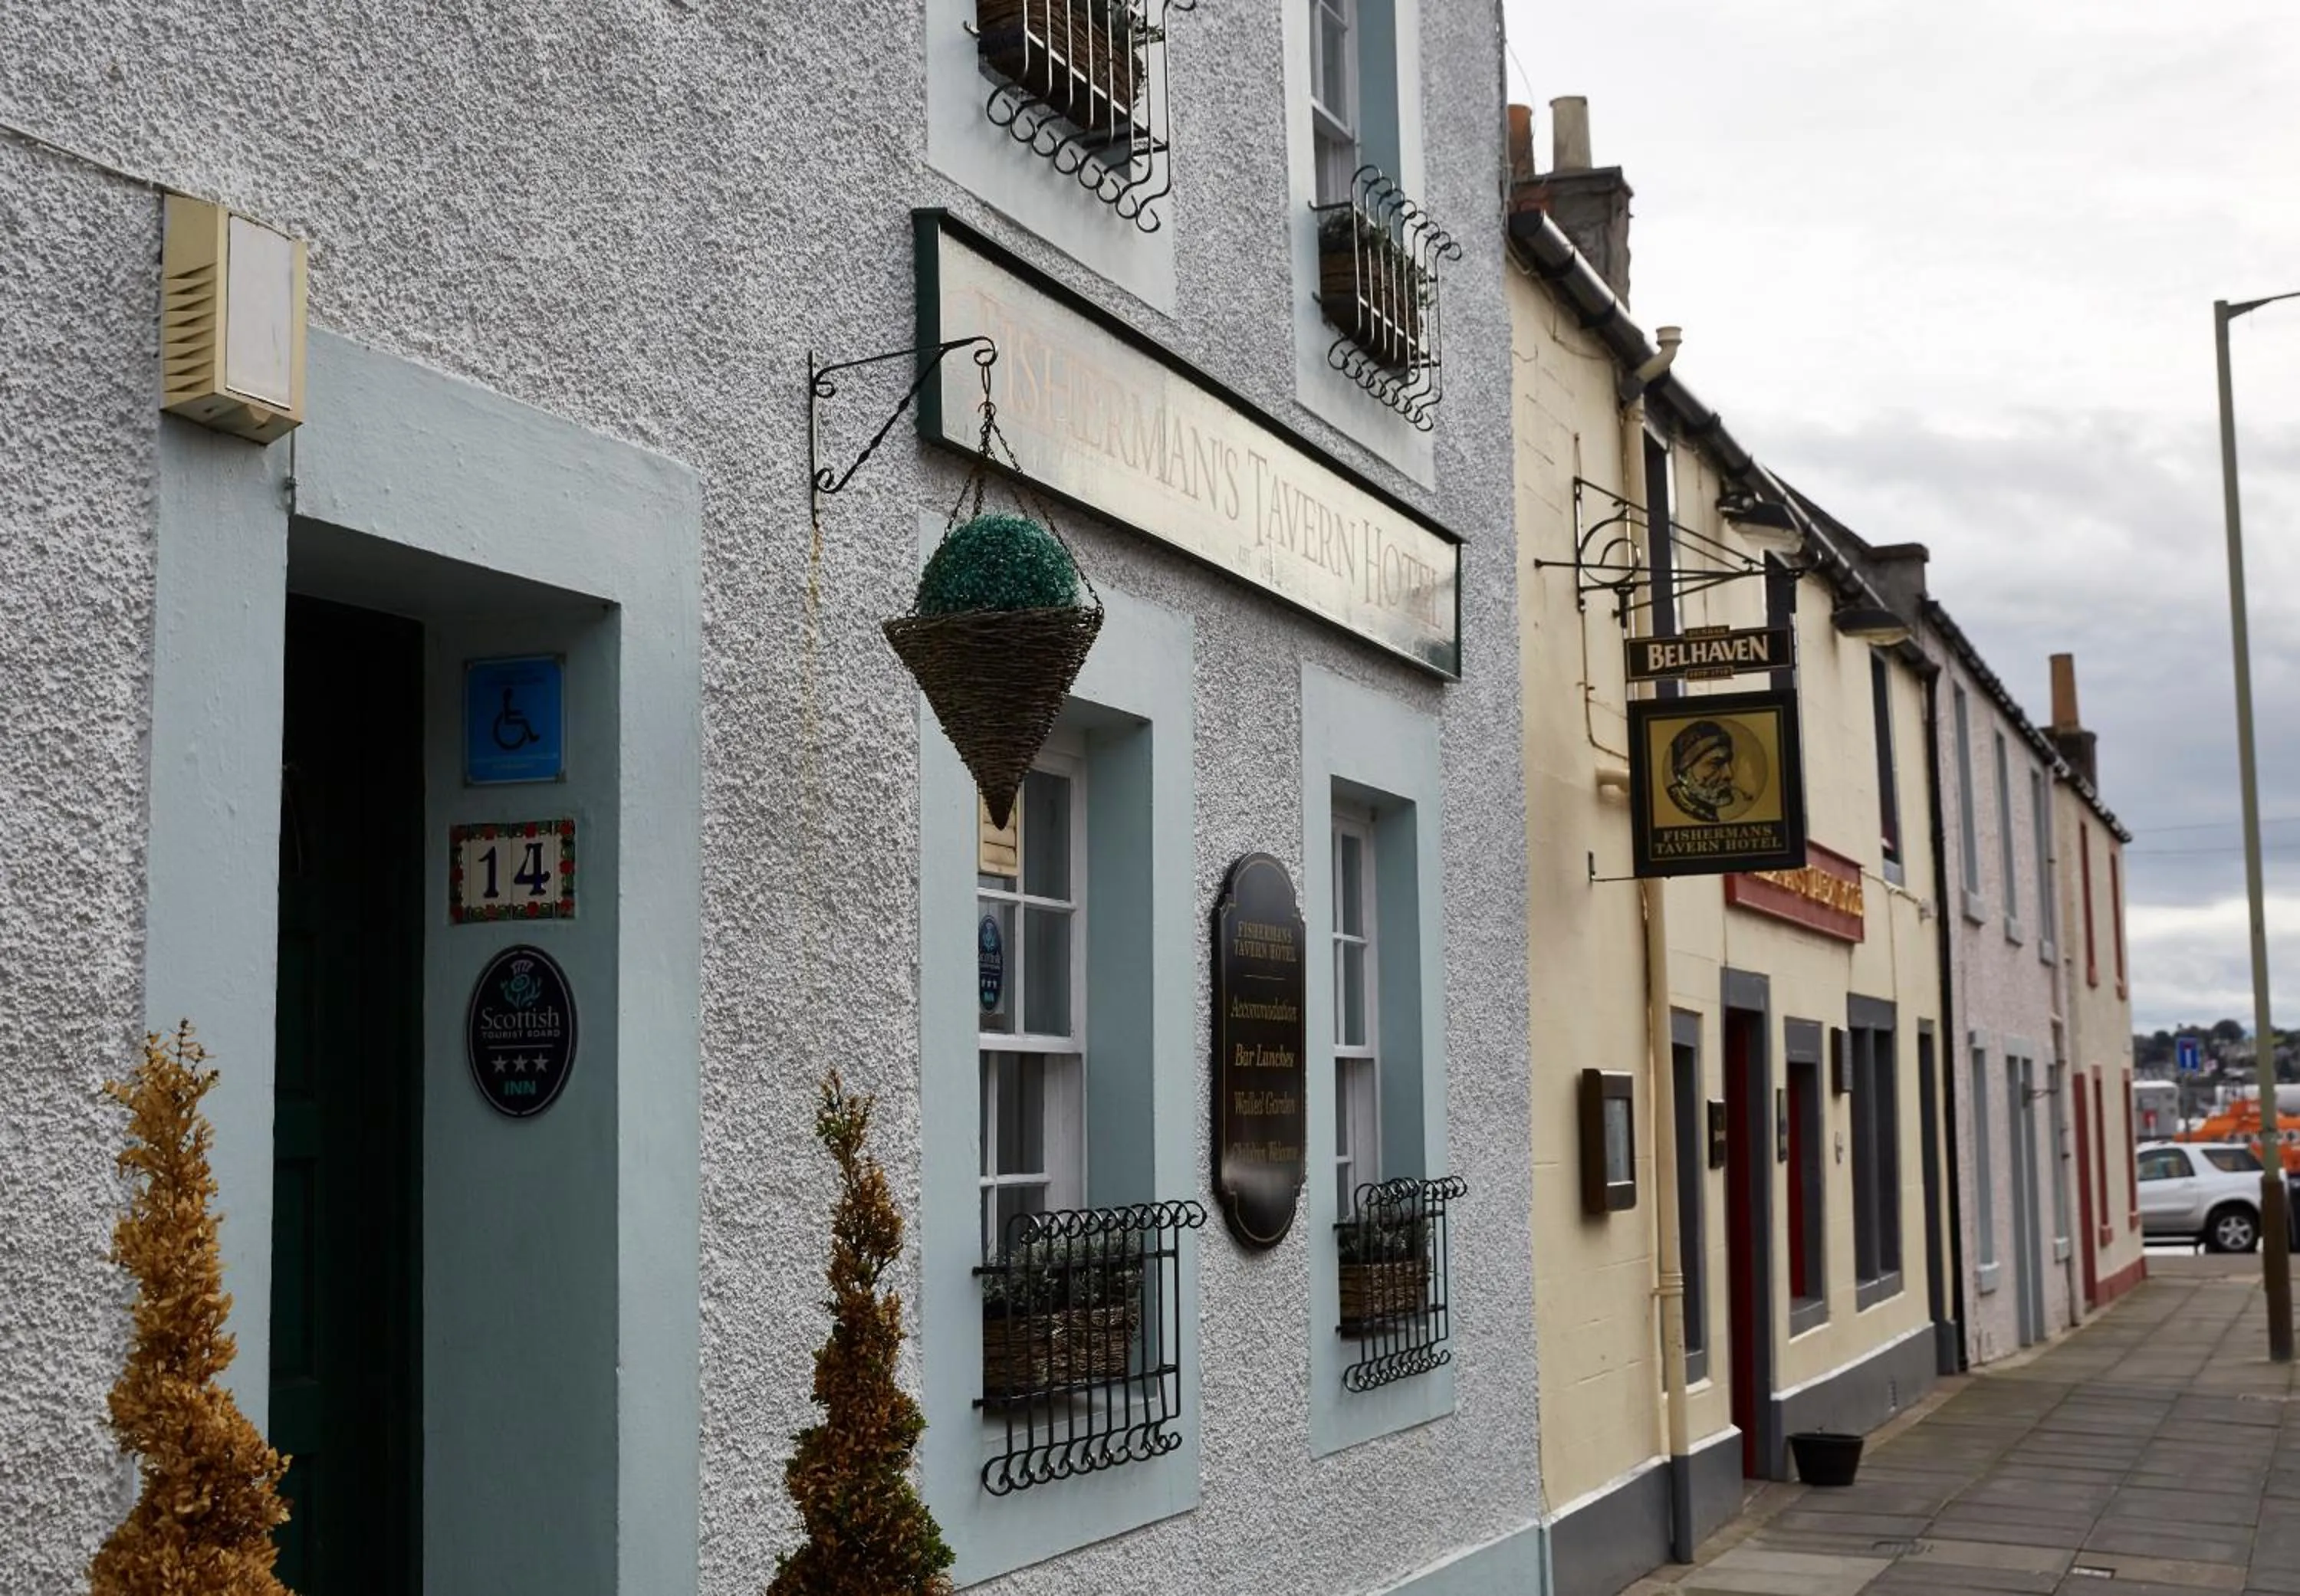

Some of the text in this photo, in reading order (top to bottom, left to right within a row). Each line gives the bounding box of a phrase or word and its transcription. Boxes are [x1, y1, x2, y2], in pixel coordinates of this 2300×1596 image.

[1247, 448, 1355, 586] TAVERN
[1362, 518, 1442, 629] HOTEL
[1648, 633, 1769, 672] BELHAVEN
[1662, 824, 1773, 842] FISHERMANS
[1654, 836, 1783, 855] TAVERN HOTEL
[477, 841, 551, 898] 14
[1233, 938, 1297, 962] TAVERN HOTEL
[481, 1005, 559, 1030] Scottish
[482, 1028, 560, 1039] TOURIST BOARD
[1235, 1043, 1295, 1068] Bar Lunches
[503, 1079, 537, 1095] INN
